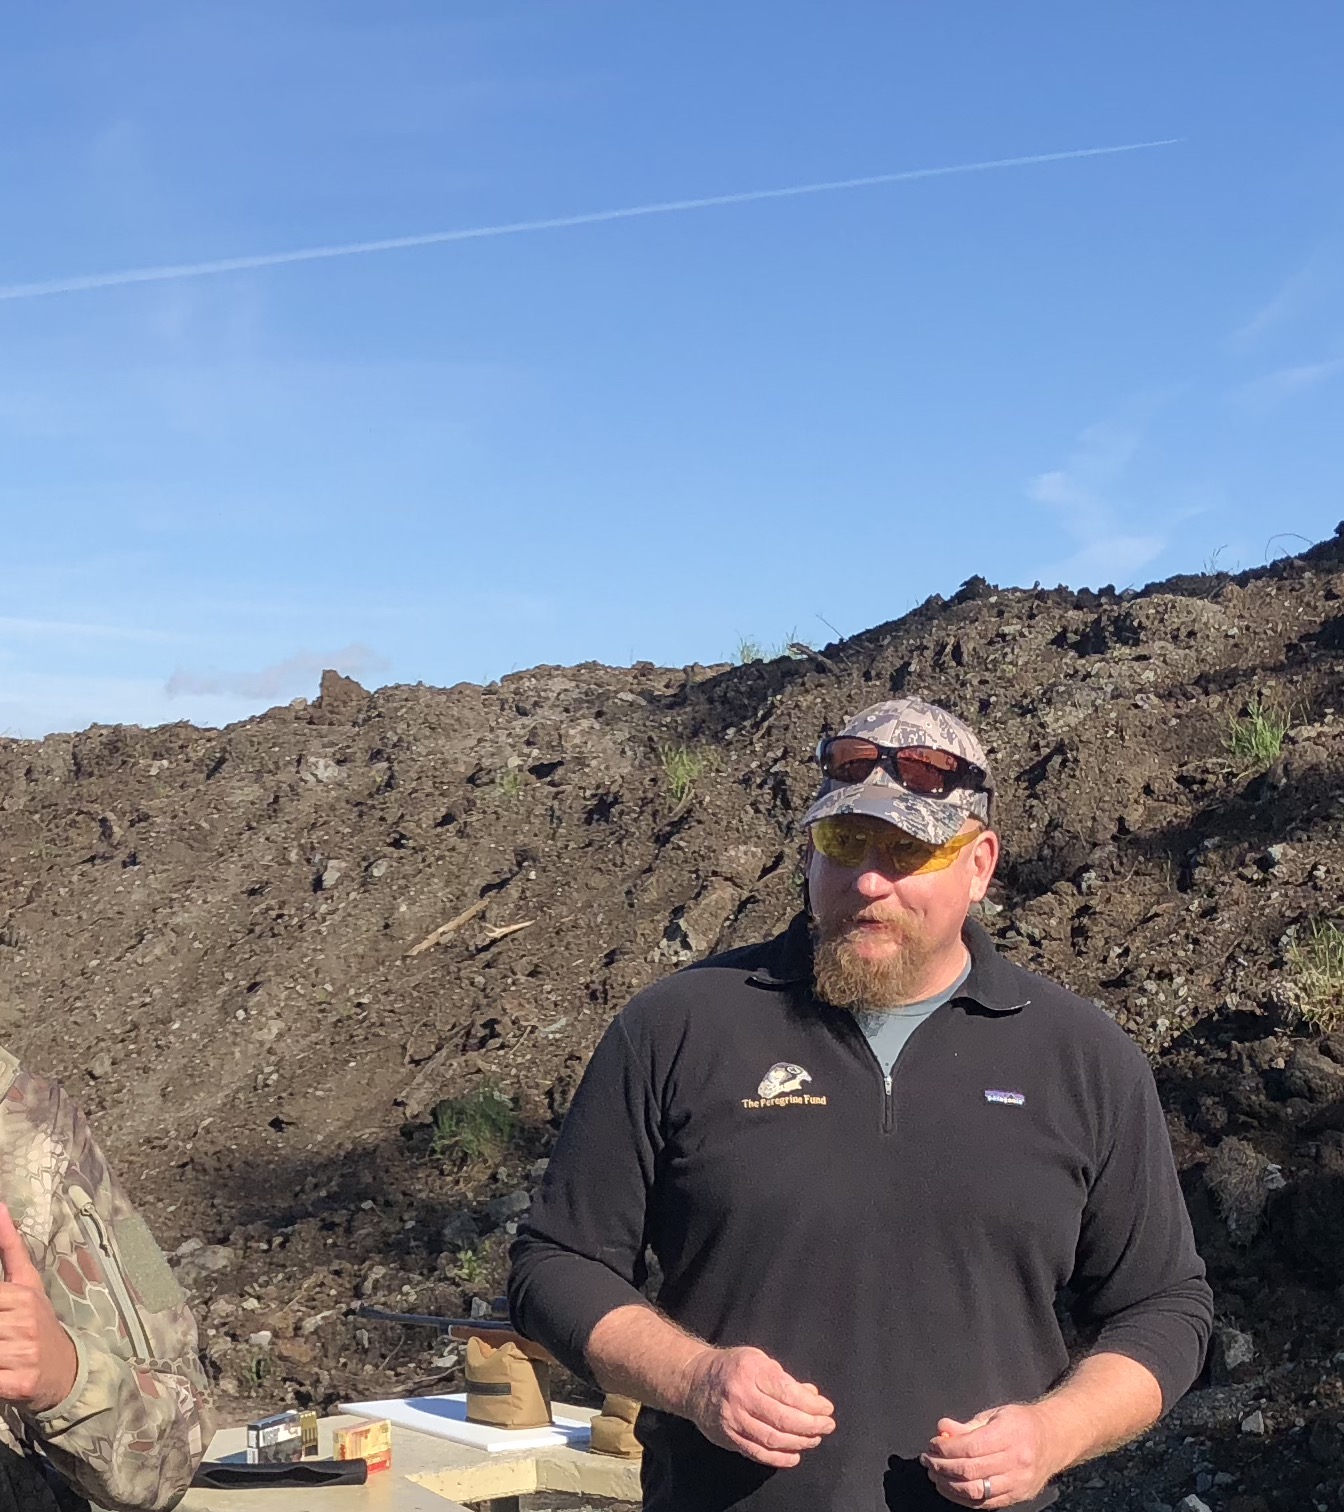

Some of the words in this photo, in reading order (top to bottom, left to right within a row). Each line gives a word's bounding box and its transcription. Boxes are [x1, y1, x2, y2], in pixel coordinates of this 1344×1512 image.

[742, 1098, 759, 1109] The
[760, 1095, 803, 1109] Peregrine
[804, 1094, 827, 1106] Fund
